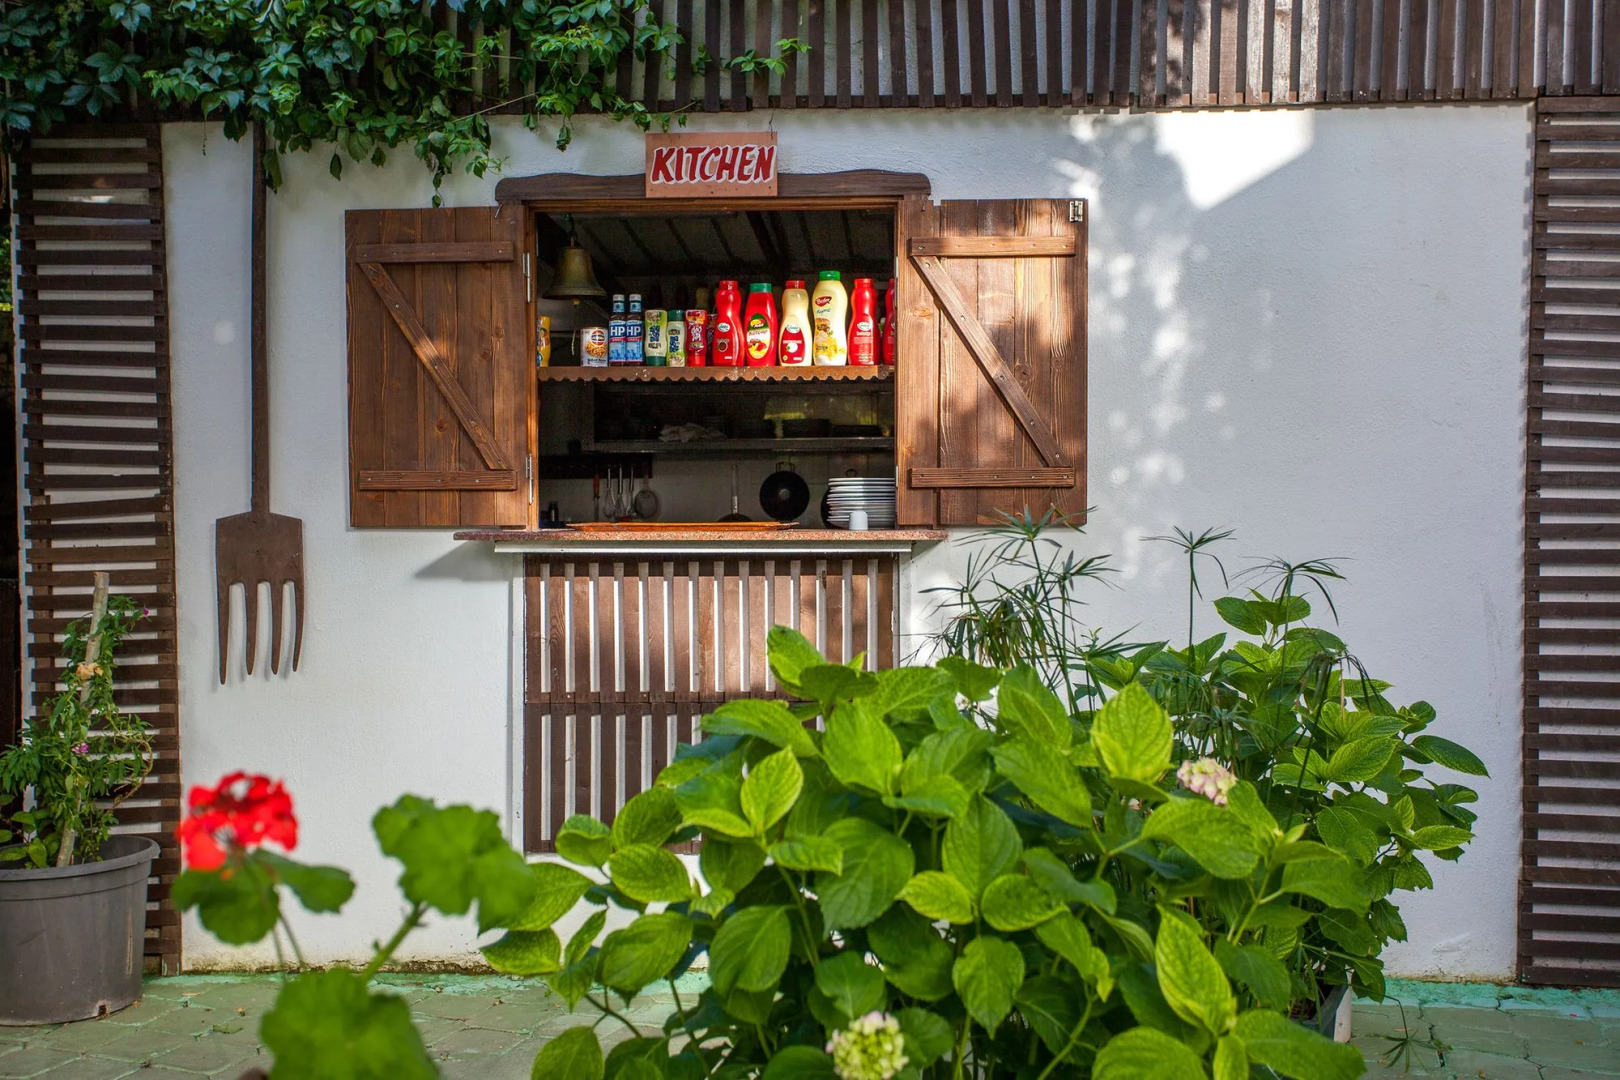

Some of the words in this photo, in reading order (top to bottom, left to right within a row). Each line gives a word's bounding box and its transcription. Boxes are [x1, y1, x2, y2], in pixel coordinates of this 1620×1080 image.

[651, 144, 777, 184] KITCHEN
[610, 326, 625, 336] HP
[627, 326, 641, 336] HP
